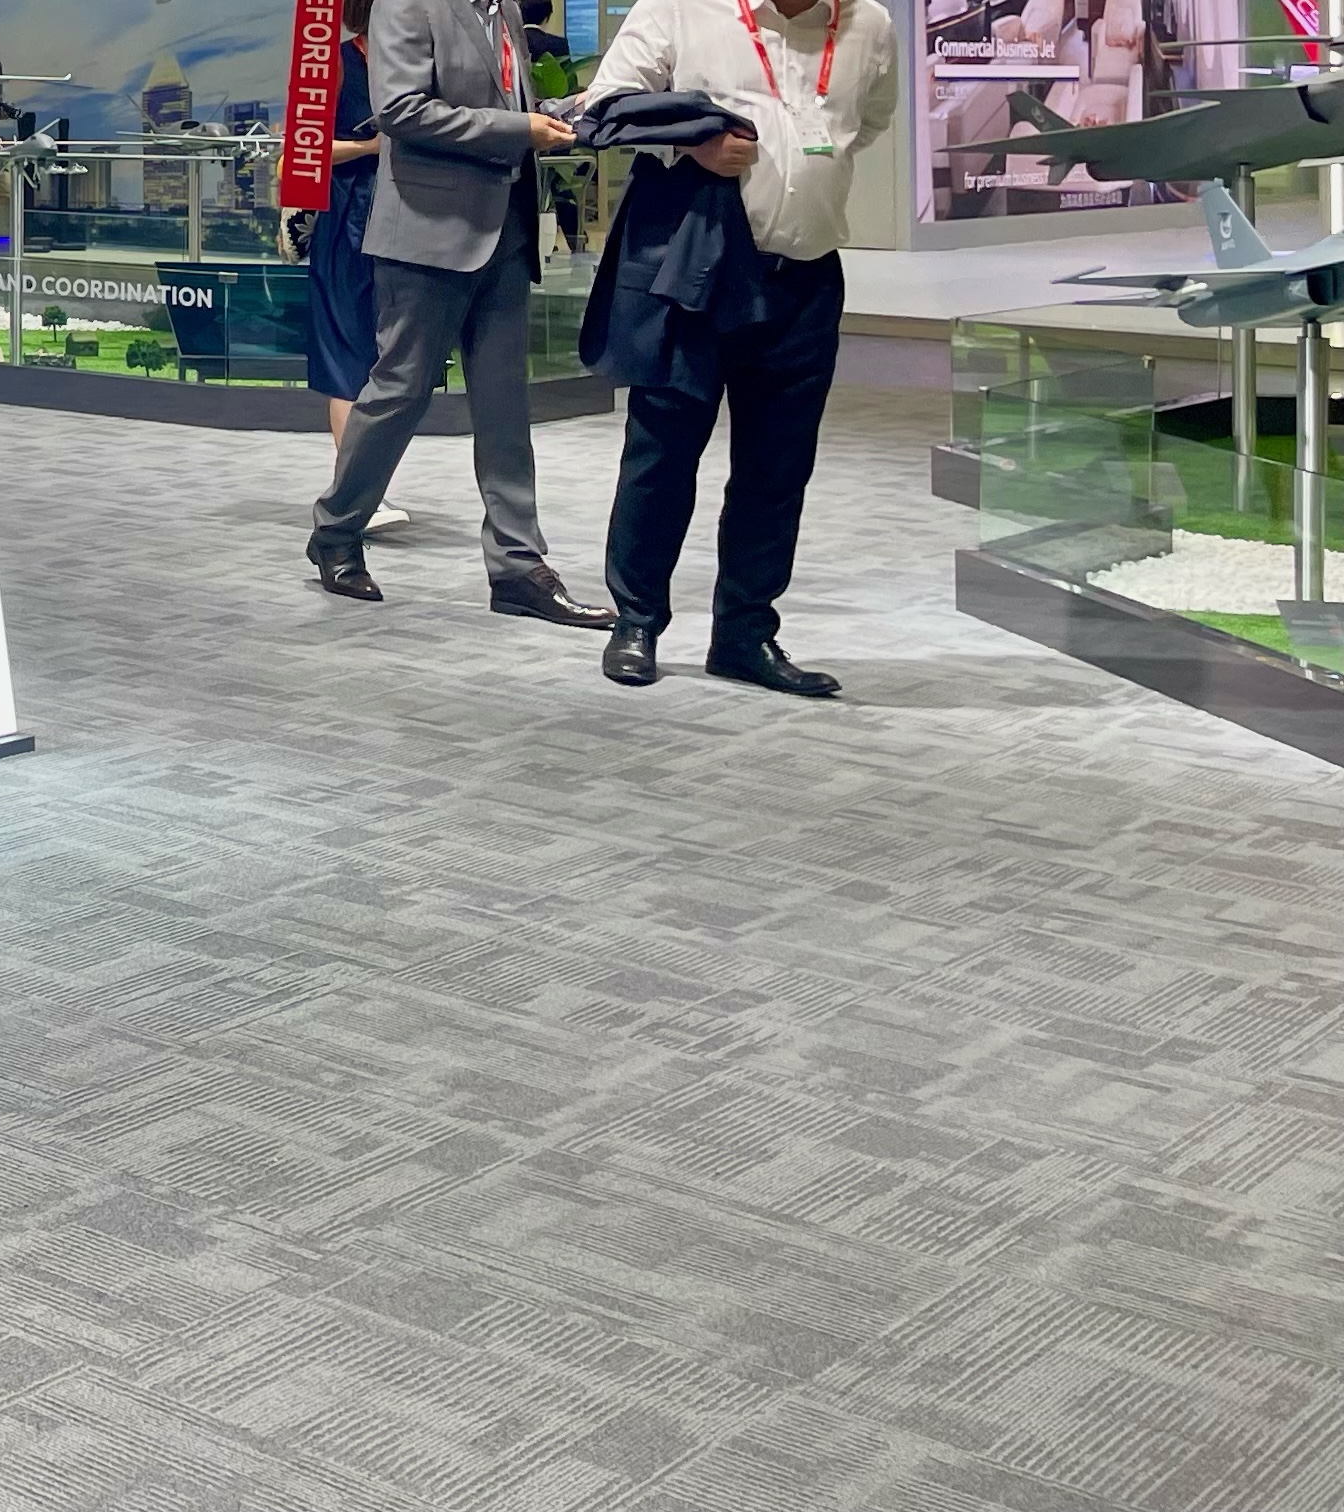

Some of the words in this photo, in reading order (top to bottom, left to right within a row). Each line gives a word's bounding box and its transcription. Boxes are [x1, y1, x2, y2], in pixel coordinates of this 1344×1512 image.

[934, 36, 994, 58] Commercial
[997, 38, 1039, 58] Business
[1040, 39, 1056, 59] Jet
[291, 87, 327, 183] FLIGHT
[41, 275, 212, 309] COORDINATION
